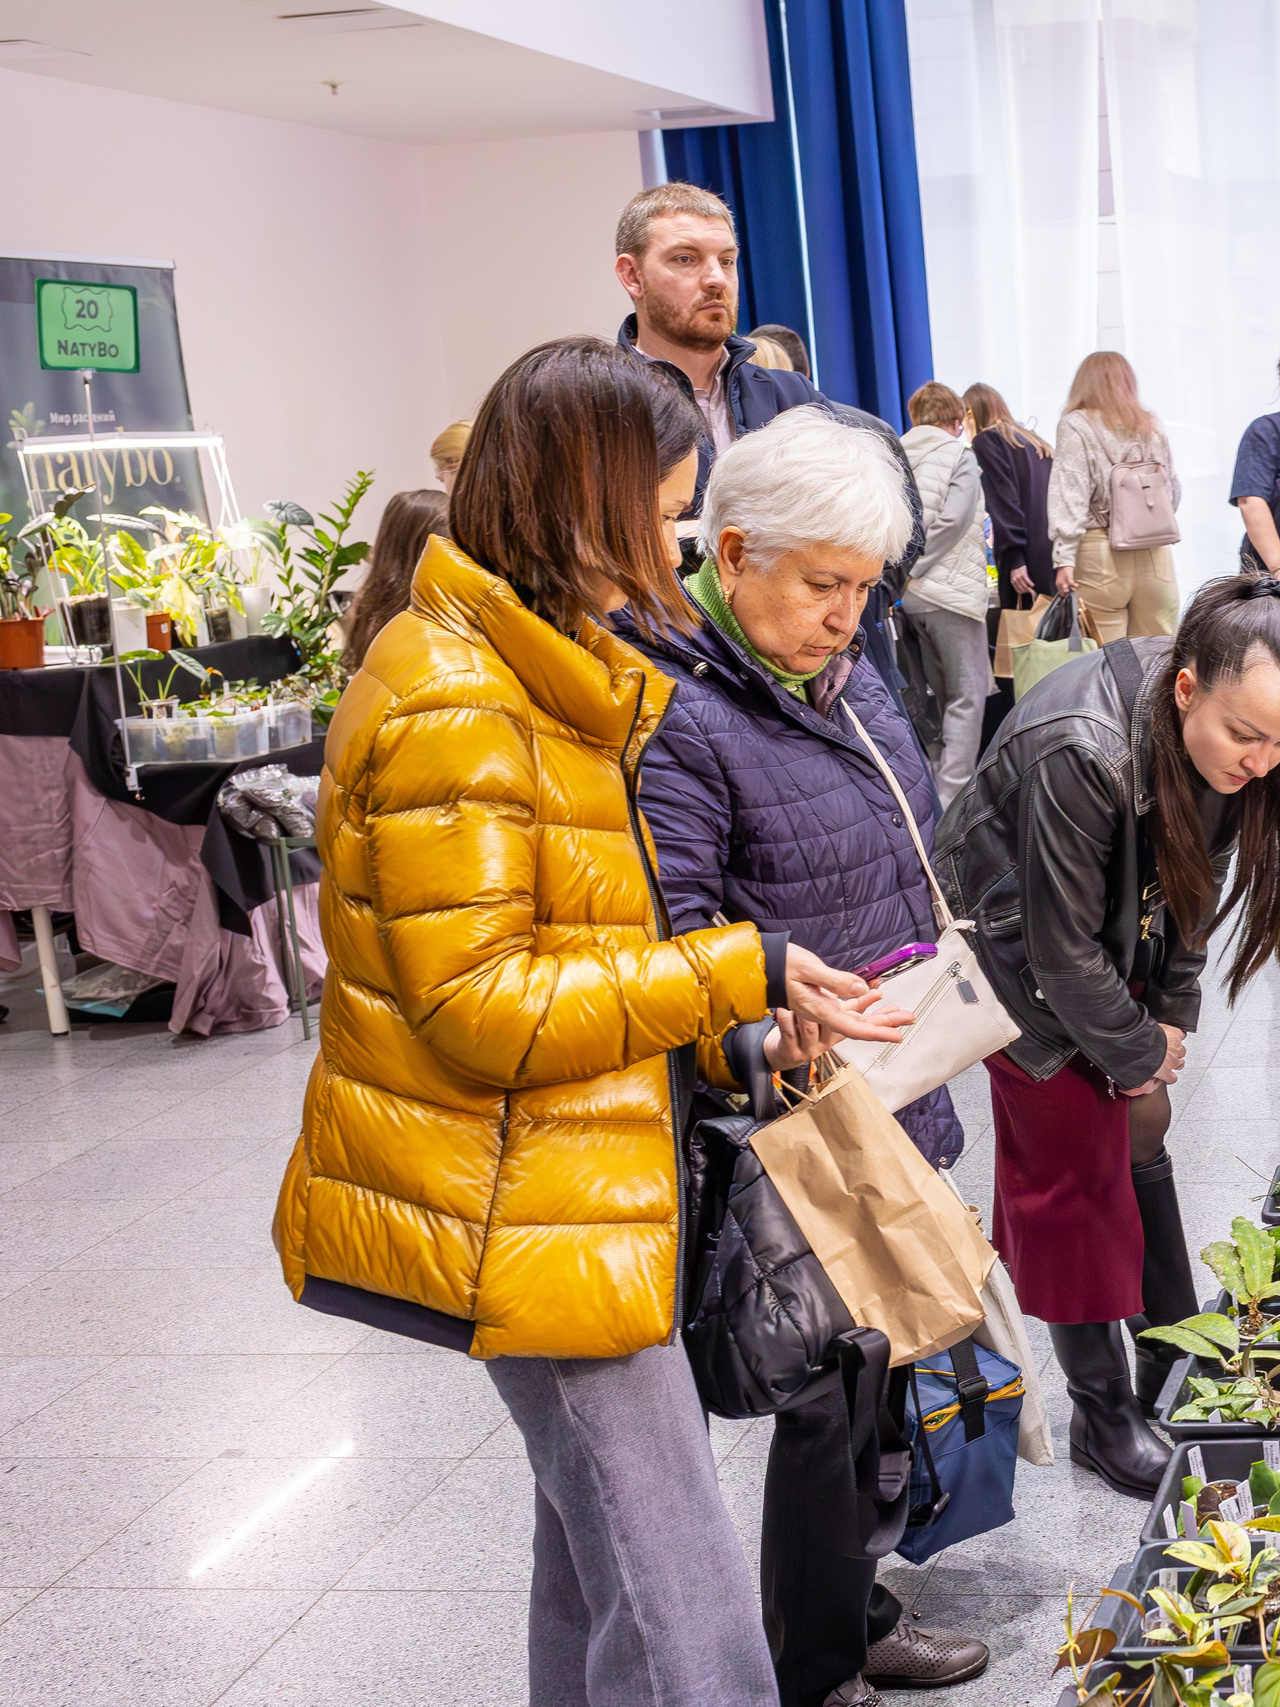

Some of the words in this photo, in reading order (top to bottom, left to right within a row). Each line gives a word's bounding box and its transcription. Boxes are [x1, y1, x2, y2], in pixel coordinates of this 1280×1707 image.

[75, 298, 99, 319] 20
[49, 412, 72, 426] Мир
[72, 410, 116, 426] расений
